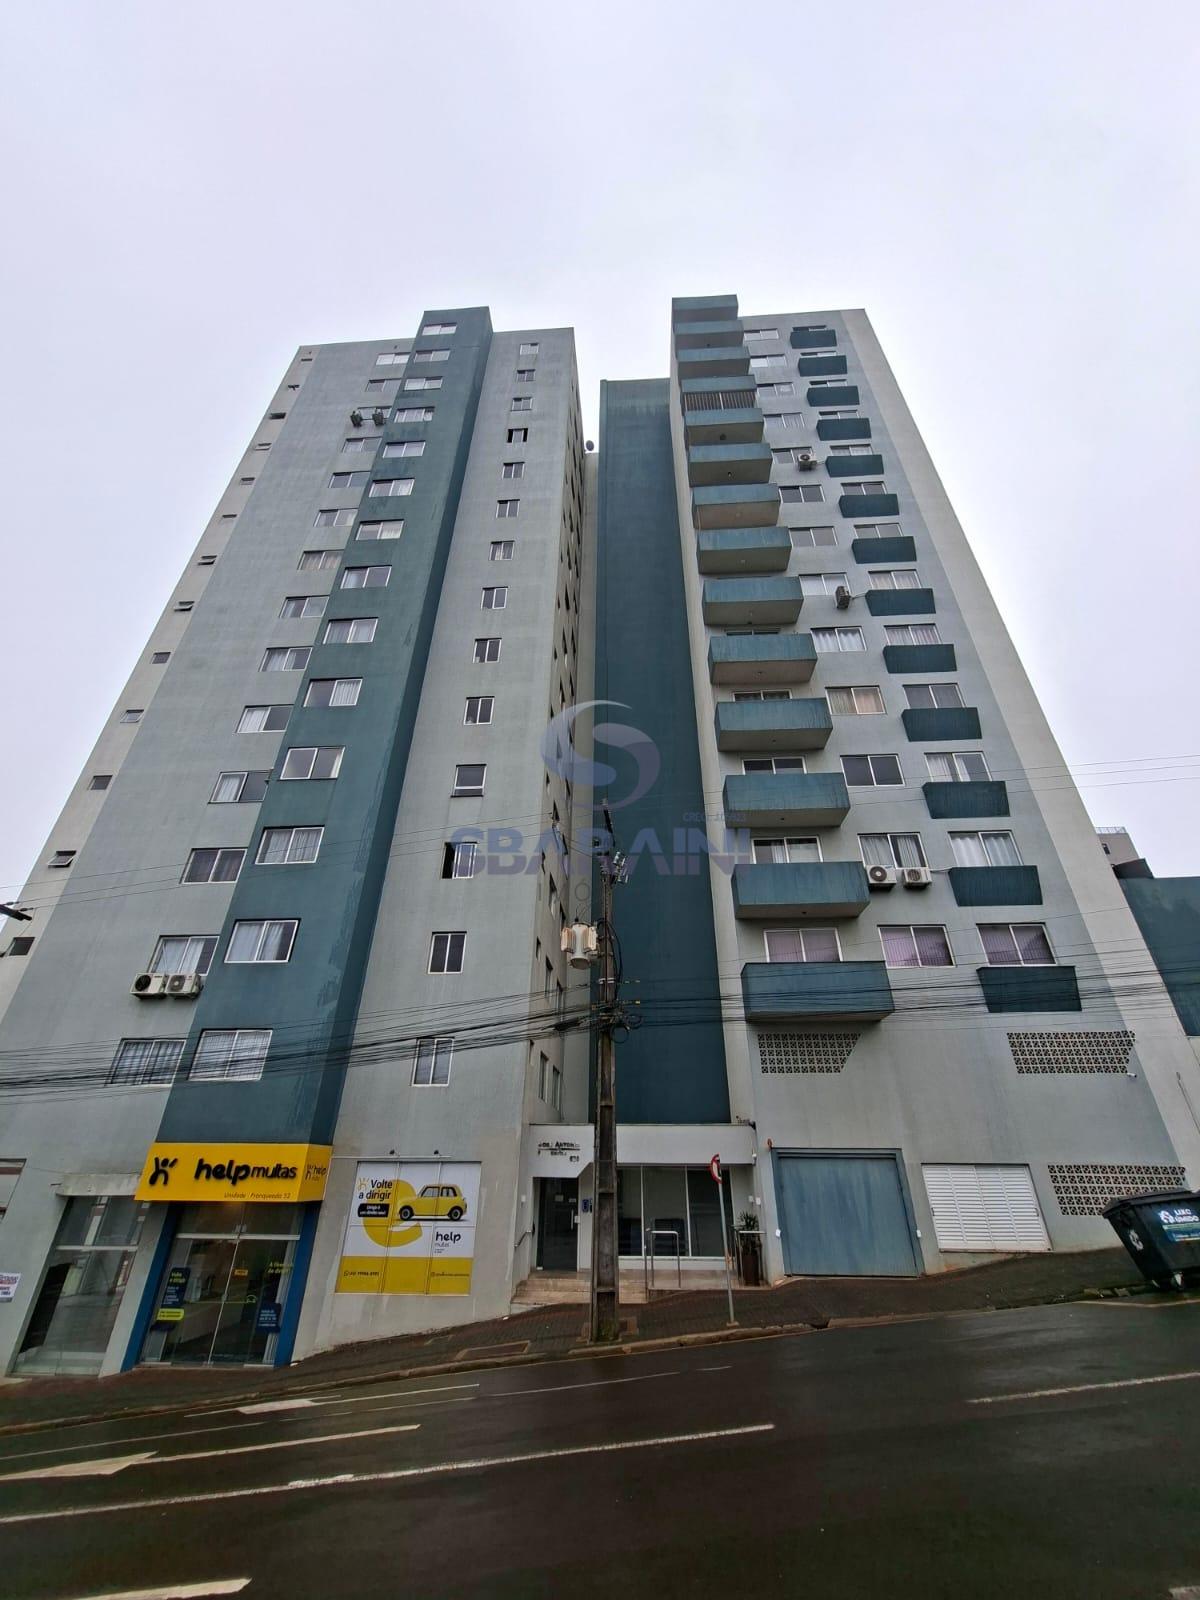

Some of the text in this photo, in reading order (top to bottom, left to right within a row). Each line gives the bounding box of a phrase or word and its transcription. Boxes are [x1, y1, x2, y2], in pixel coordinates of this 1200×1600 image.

[194, 1158, 298, 1186] helpmultas
[371, 1179, 393, 1189] Volte
[358, 1190, 391, 1201] a dirigir
[435, 1231, 462, 1243] help
